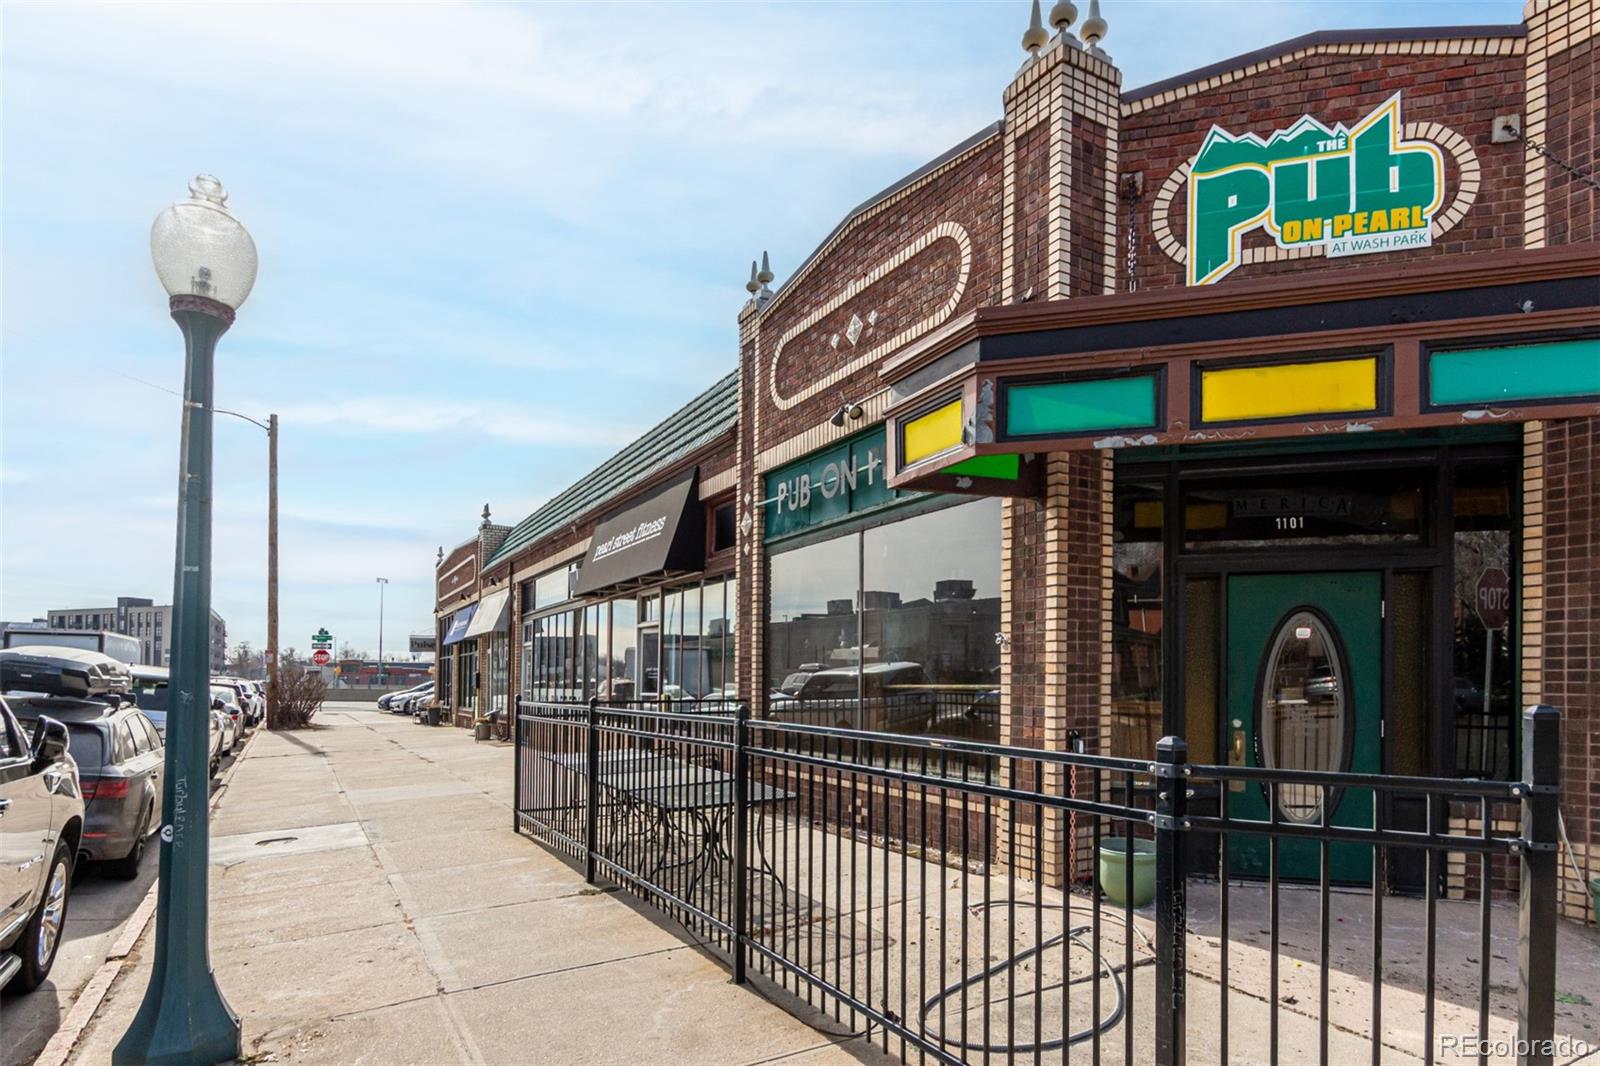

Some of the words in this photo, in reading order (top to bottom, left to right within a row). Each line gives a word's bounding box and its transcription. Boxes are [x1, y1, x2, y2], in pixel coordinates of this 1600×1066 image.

[1316, 138, 1347, 152] THE
[1282, 217, 1323, 243] ON
[1332, 205, 1427, 238] PEARL
[1332, 241, 1349, 253] AT
[1351, 236, 1390, 250] WASH
[1393, 232, 1427, 246] PARK
[777, 474, 811, 515] PUB
[820, 455, 857, 499] ON
[1275, 516, 1304, 530] 1101
[593, 536, 616, 560] pearl
[612, 527, 638, 550] street
[635, 516, 668, 541] fitness
[314, 653, 330, 661] STOP
